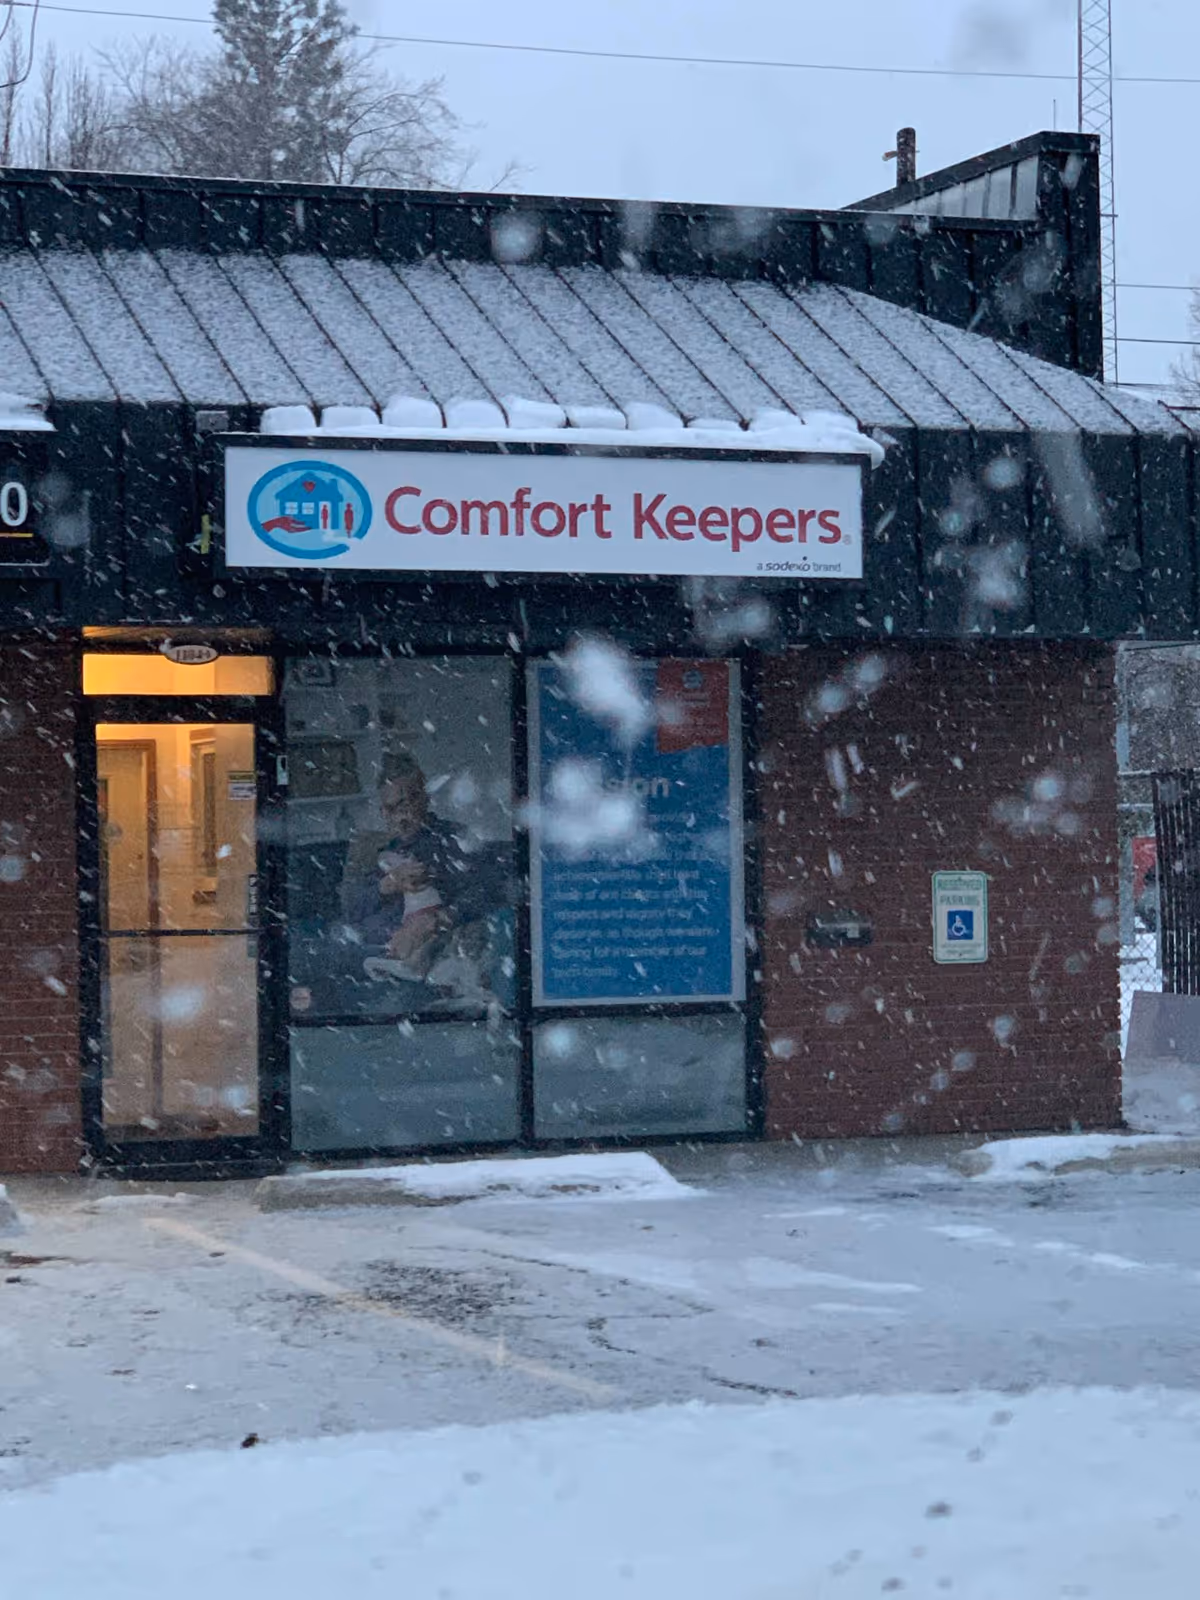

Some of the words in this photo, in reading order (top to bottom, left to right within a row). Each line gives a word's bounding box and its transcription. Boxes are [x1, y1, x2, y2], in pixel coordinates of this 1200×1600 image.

[384, 486, 612, 539] Comfort
[633, 493, 842, 552] Keepers
[812, 562, 841, 572] brand
